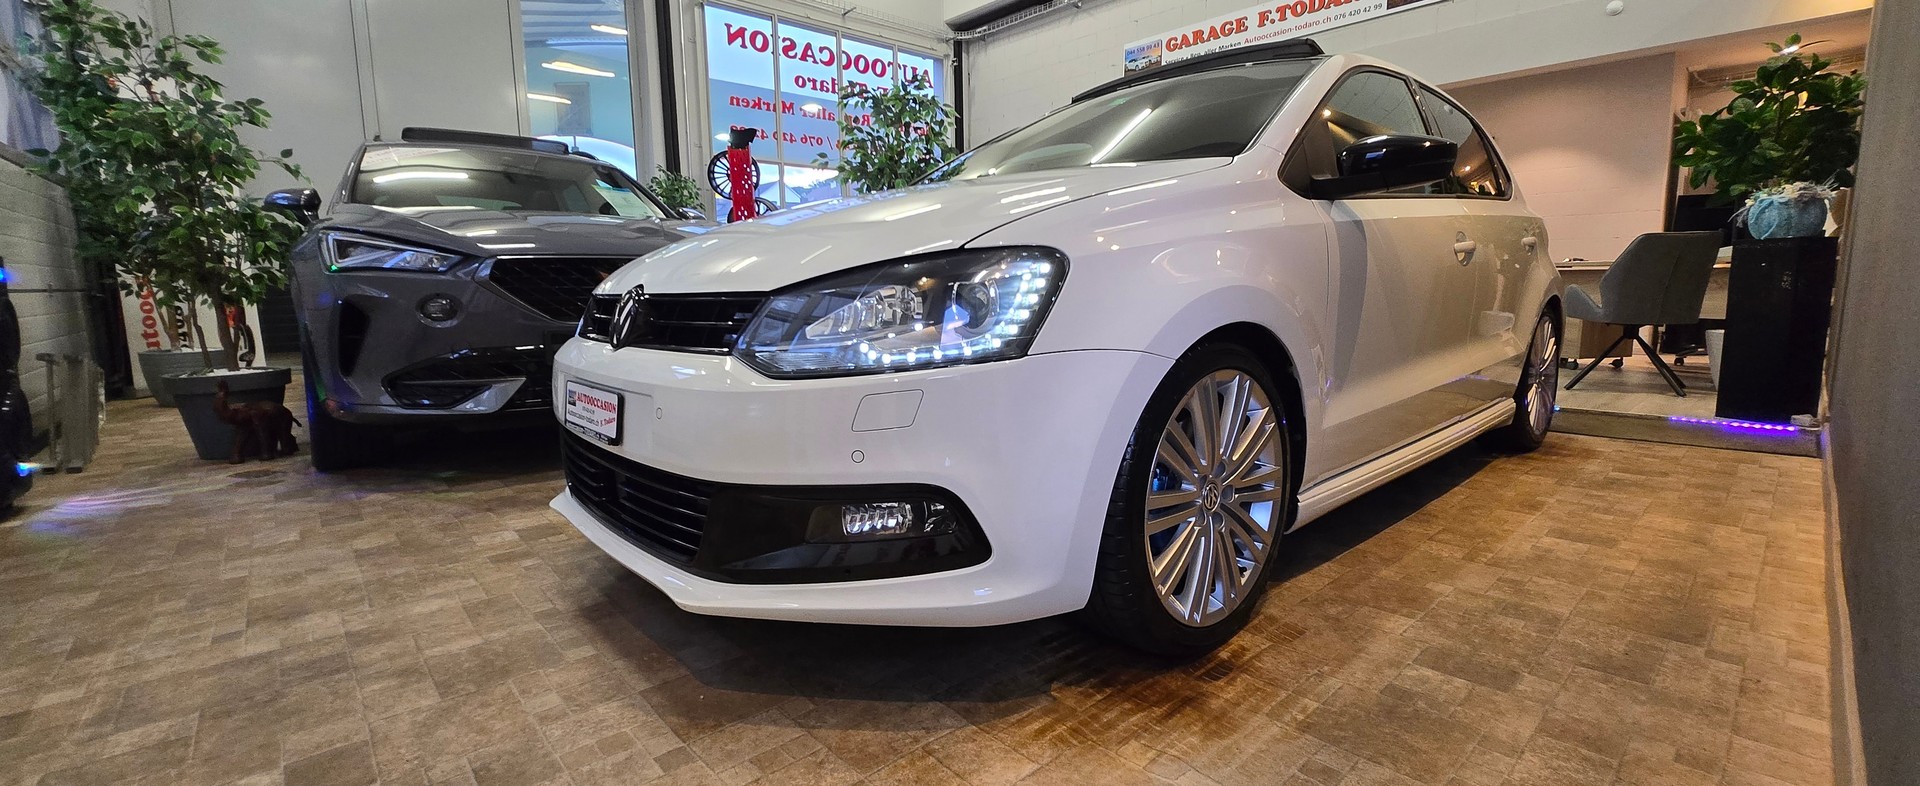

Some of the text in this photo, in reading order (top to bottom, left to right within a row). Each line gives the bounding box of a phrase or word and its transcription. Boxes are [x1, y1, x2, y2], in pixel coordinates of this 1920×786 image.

[1165, 0, 1359, 53] GARAGE F.TODA
[1219, 41, 1241, 51] Marken
[1244, 15, 1332, 45] Autooccasion-todaro.ch
[1334, 13, 1347, 21] 076
[1348, 8, 1361, 17] 420
[1363, 5, 1371, 13] 42
[1374, 2, 1383, 11] 99
[576, 391, 616, 414] AUTOOCCASION
